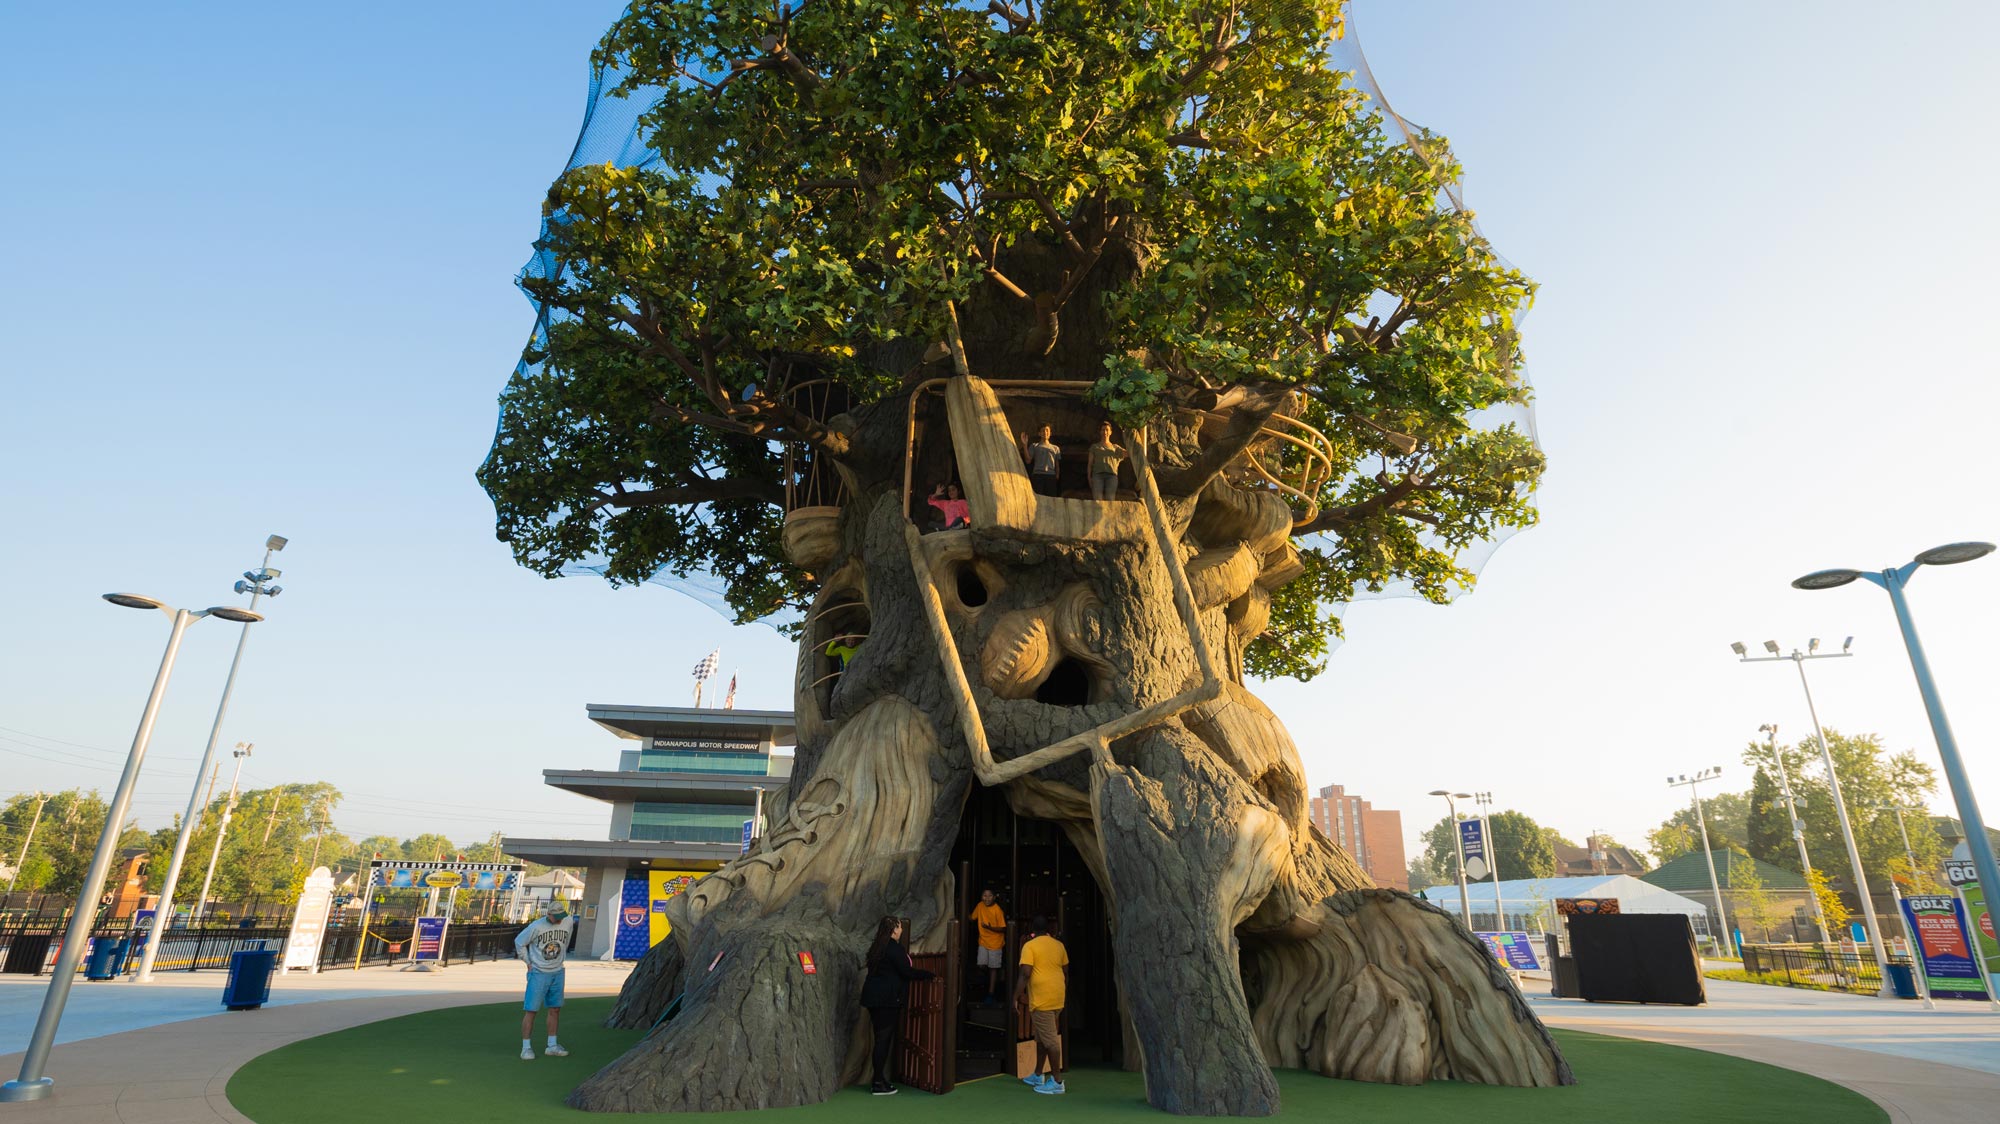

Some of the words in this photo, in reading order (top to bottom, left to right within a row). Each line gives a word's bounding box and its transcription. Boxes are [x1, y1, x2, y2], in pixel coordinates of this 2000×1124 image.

[654, 740, 697, 748] INDIANAPOLIS
[724, 742, 759, 750] SPEEDWAY
[446, 863, 512, 871] EXPERIENCE
[1948, 866, 1978, 882] GO
[1911, 899, 1951, 910] GOLF
